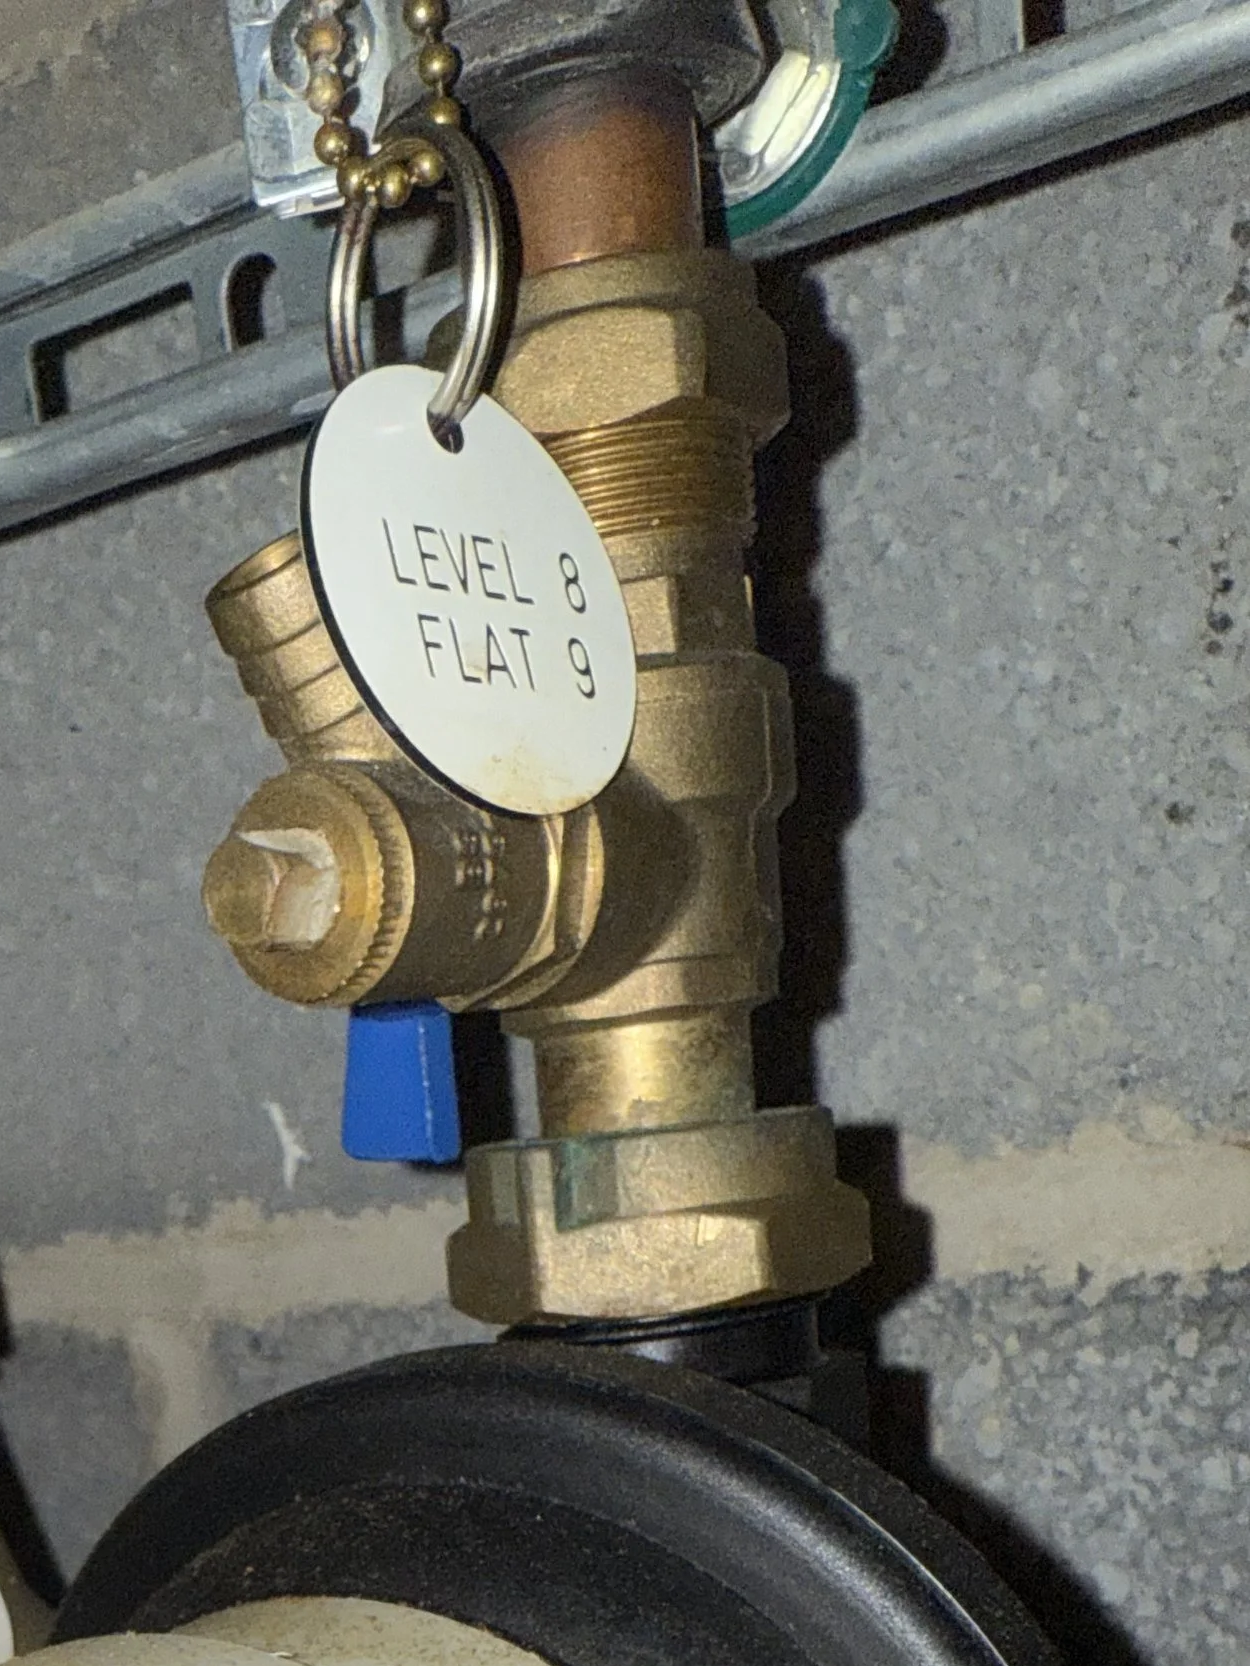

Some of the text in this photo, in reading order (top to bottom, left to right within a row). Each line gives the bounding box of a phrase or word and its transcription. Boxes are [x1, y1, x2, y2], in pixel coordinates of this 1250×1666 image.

[382, 517, 587, 614] LEVEL 8
[417, 612, 596, 699] FLAT 9
